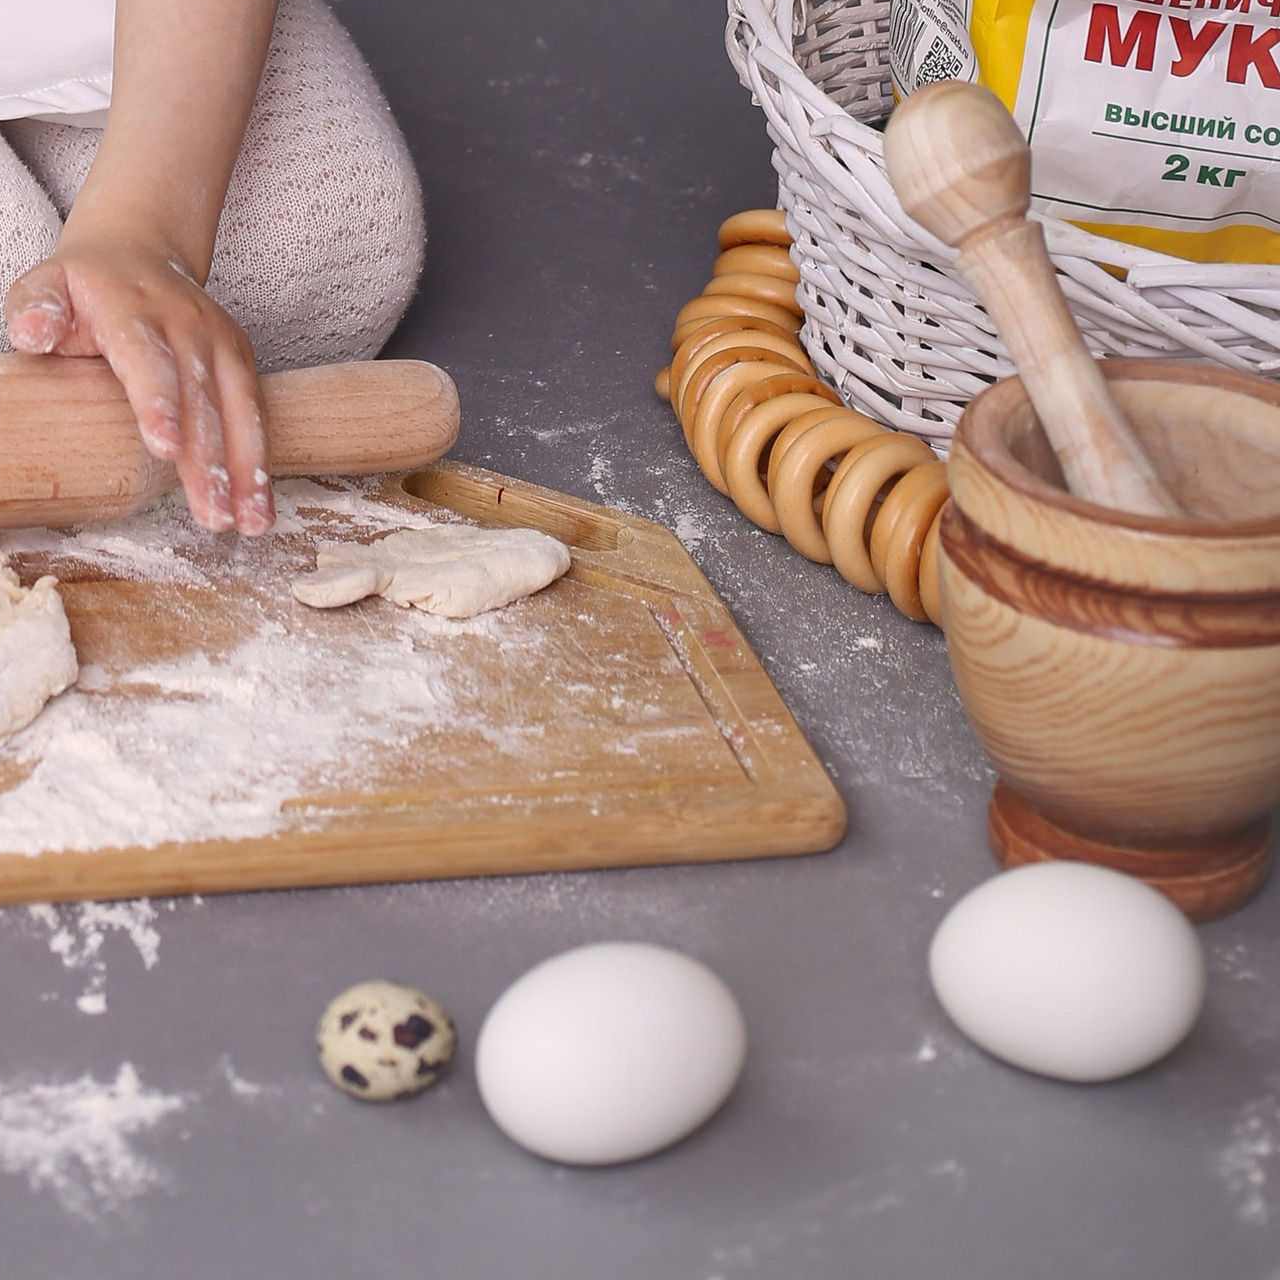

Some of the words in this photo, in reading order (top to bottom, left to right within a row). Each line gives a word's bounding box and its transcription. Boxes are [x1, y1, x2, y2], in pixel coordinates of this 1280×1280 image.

[1084, 3, 1280, 90] МУК
[1161, 154, 1190, 182] 2
[1196, 165, 1246, 188] кг
